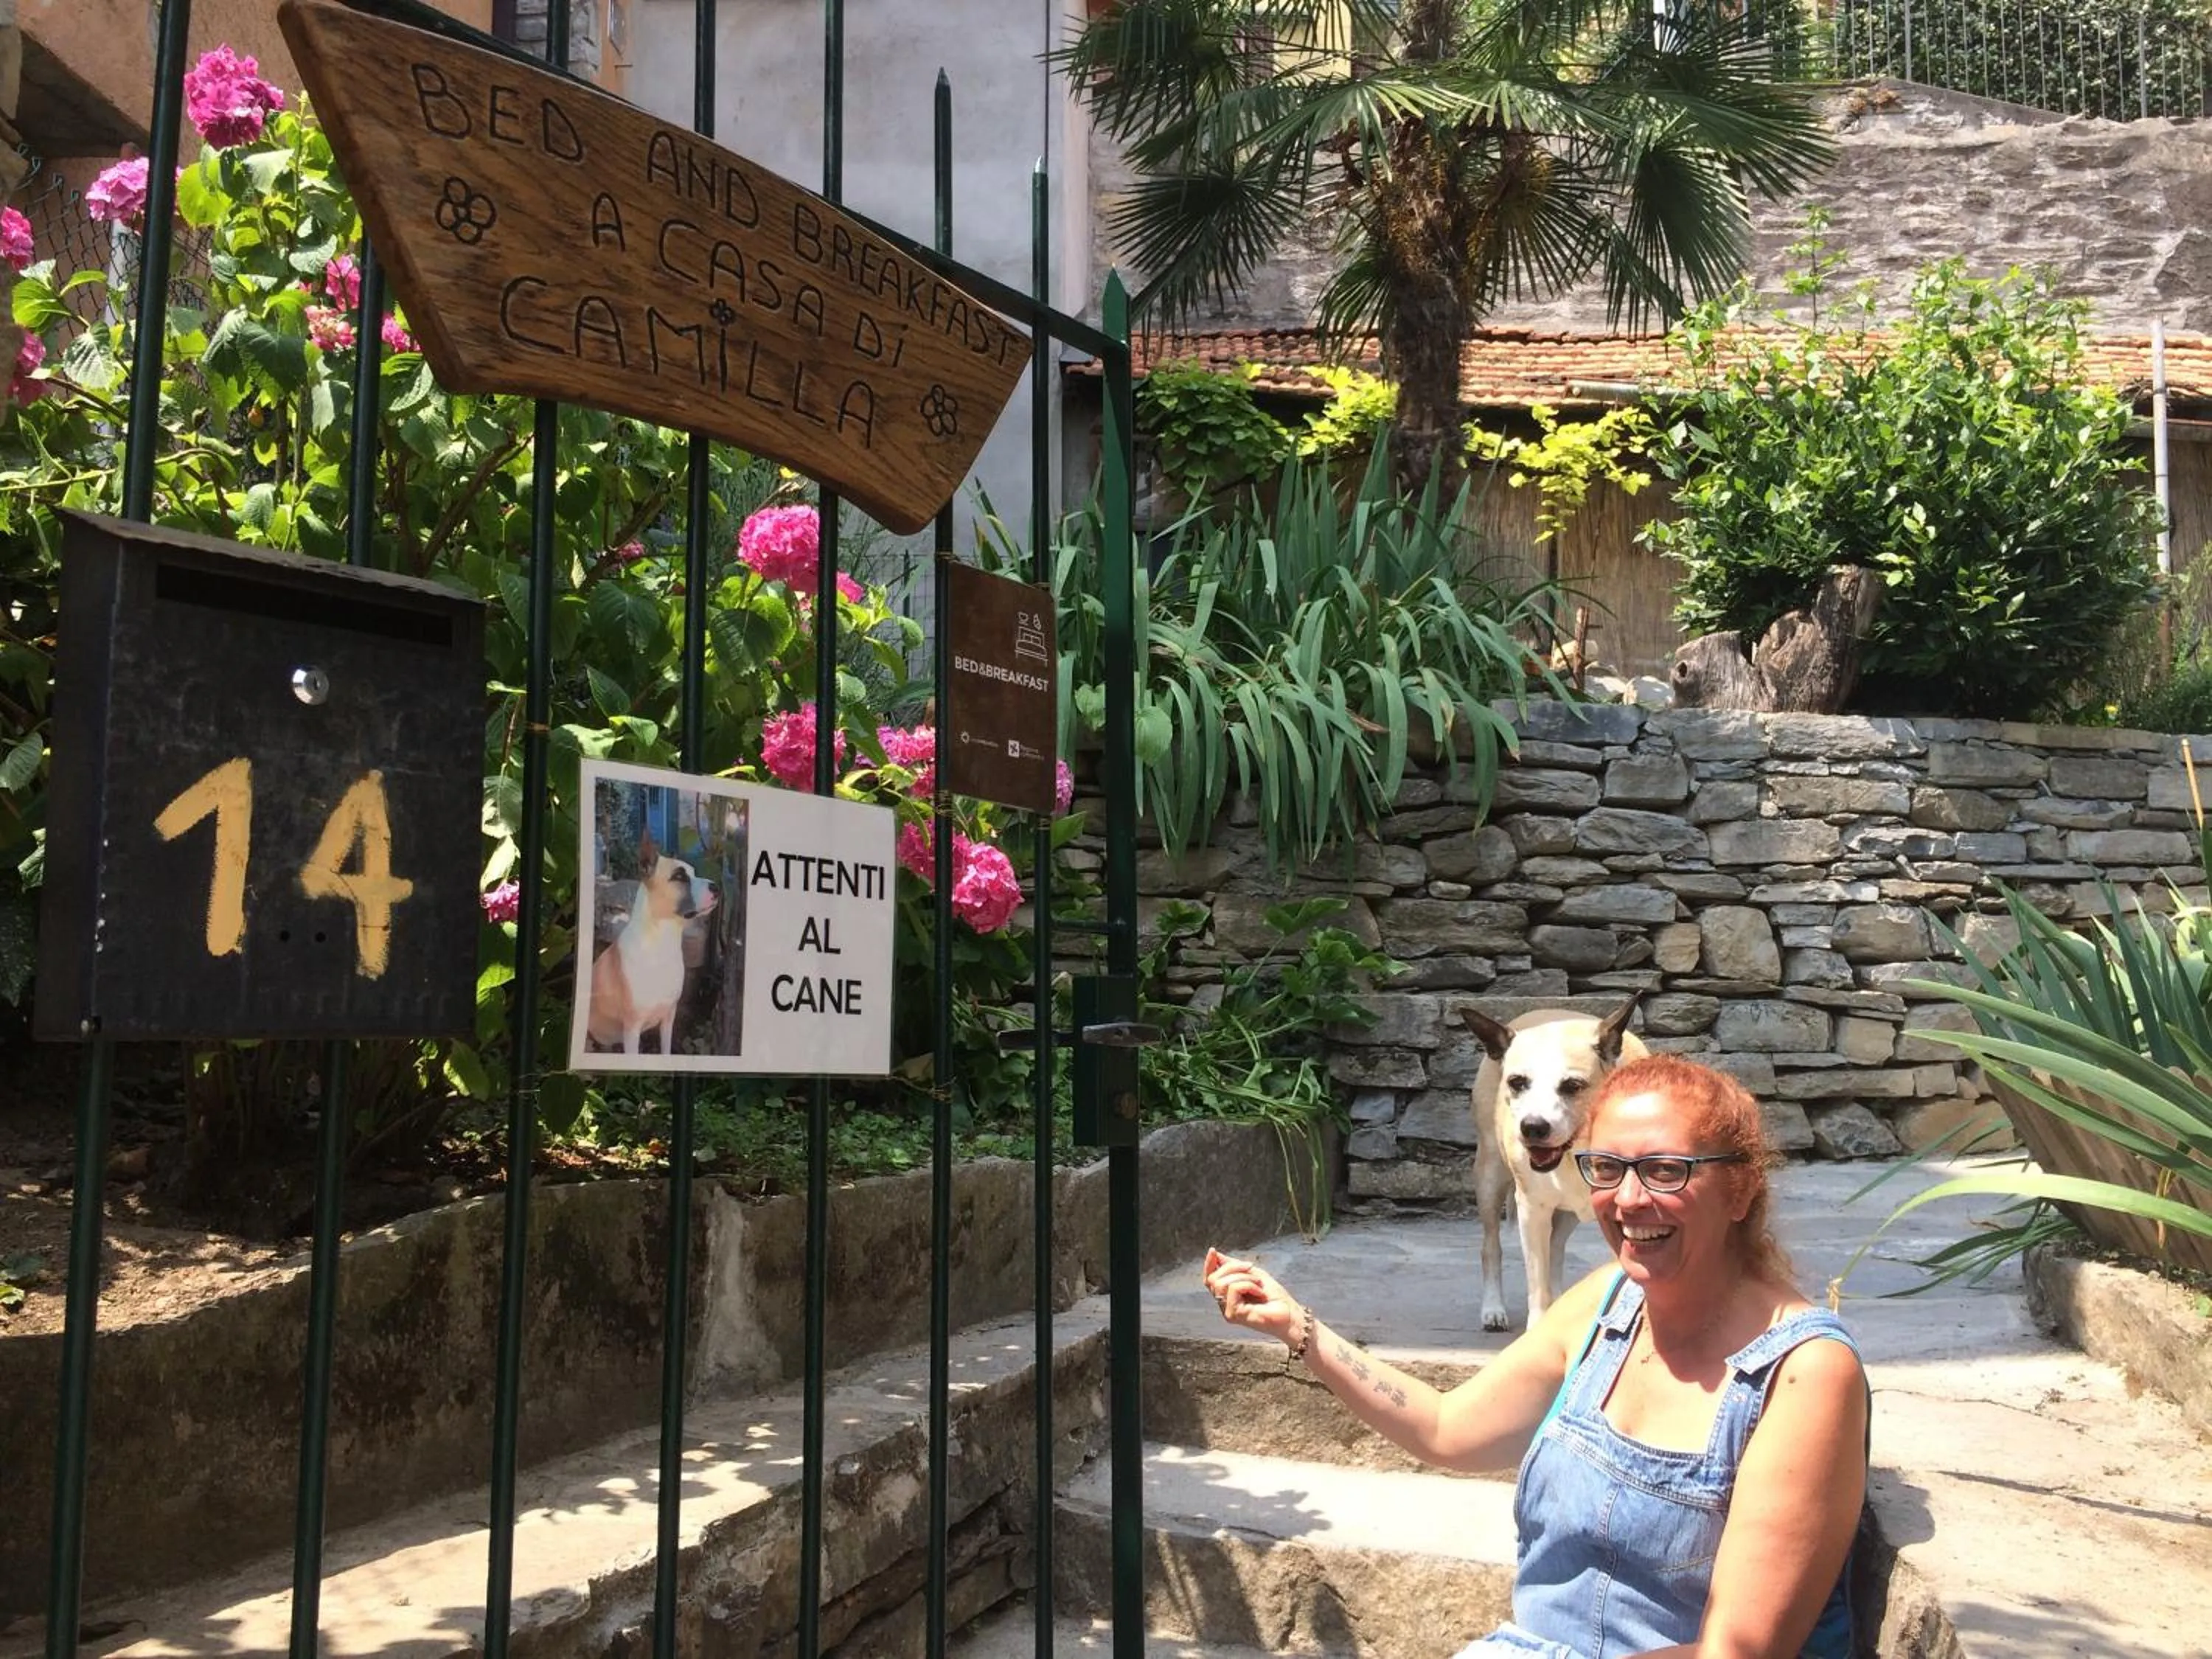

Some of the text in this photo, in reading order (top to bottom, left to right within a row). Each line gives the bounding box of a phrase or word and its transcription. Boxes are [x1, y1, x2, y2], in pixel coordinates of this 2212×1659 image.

[411, 63, 1018, 366] BED AND BREAKFAST
[592, 192, 625, 252] A
[658, 219, 826, 337] CASA
[954, 656, 1048, 692] BED&BREAKFAST
[153, 757, 414, 979] 14
[751, 850, 885, 900] ATTENTI
[798, 917, 841, 955] AL
[771, 974, 862, 1015] CANE
